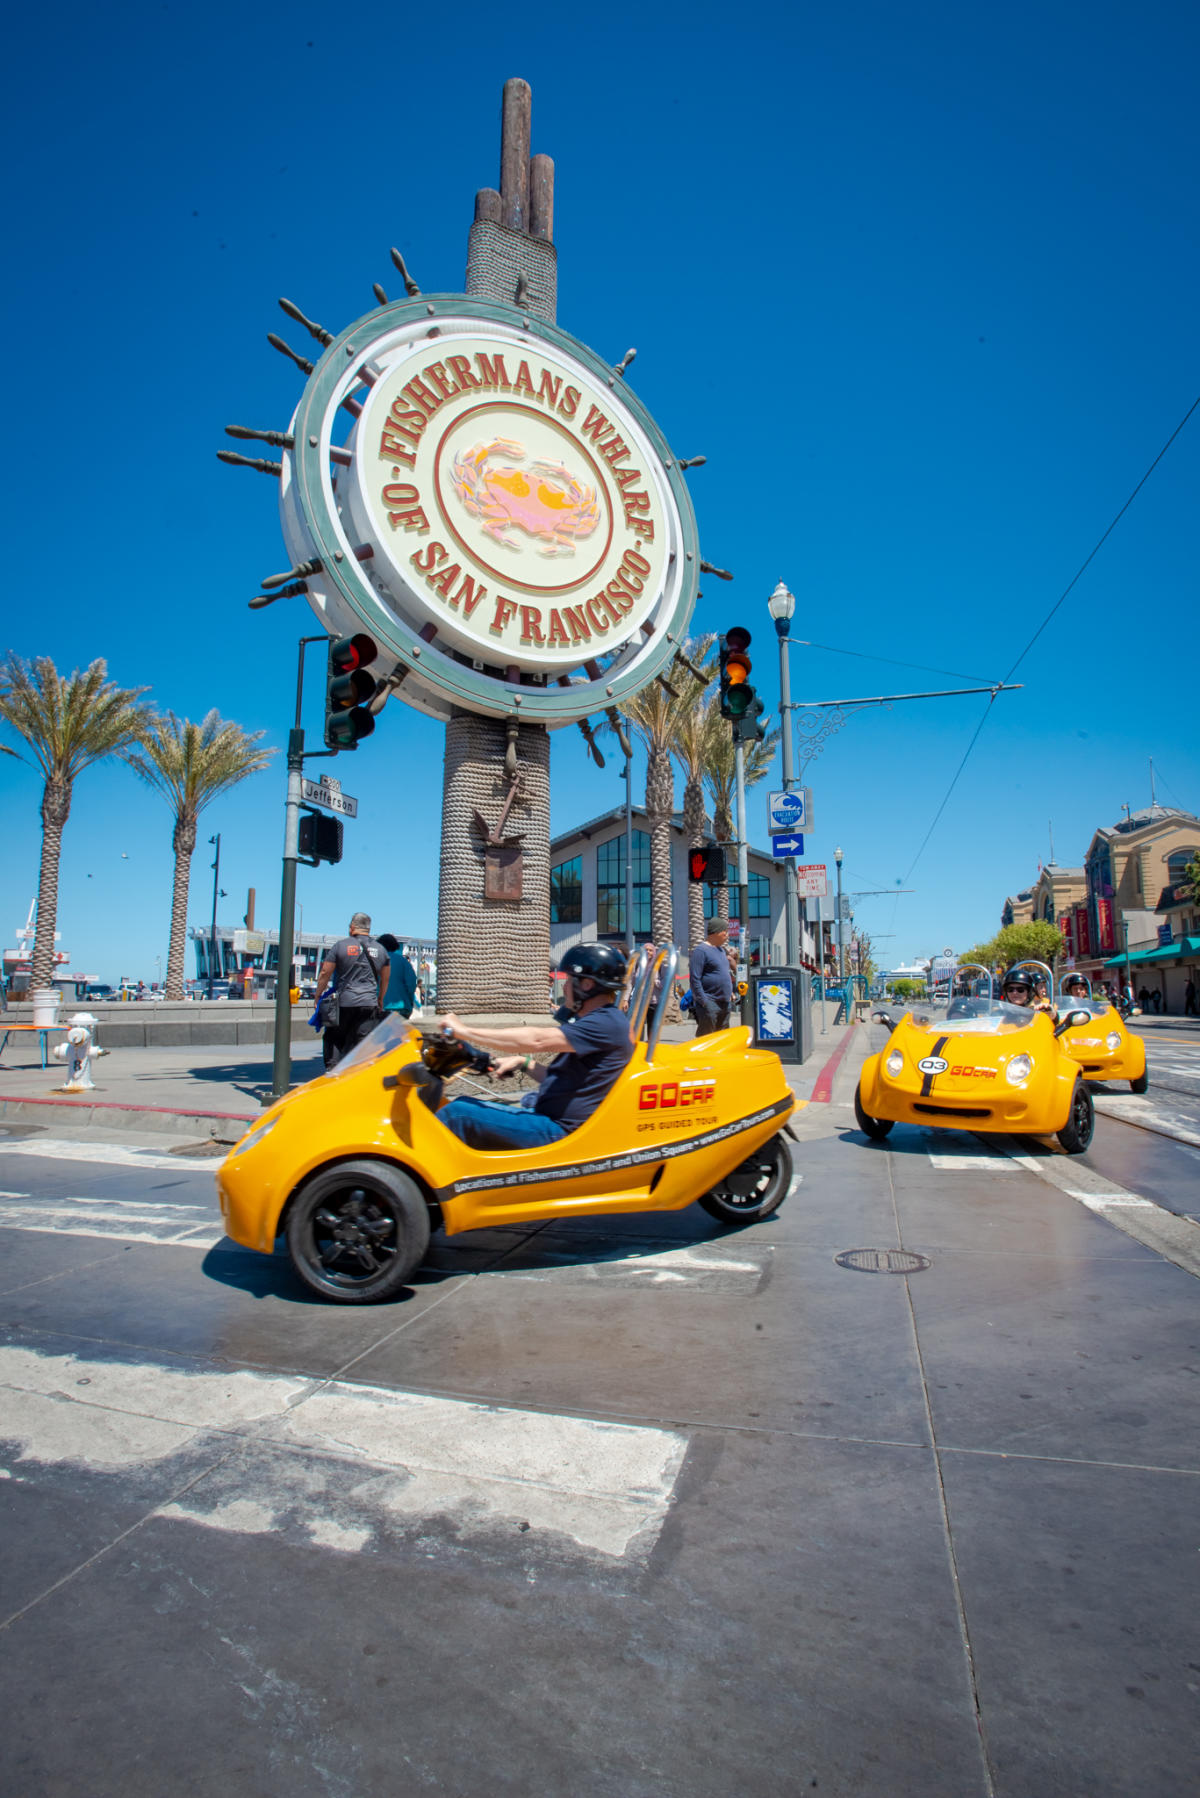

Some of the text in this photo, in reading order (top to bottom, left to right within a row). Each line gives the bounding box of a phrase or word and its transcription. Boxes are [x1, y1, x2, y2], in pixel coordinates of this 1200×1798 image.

[379, 351, 655, 543] FISHERMANS WHARF
[382, 483, 652, 644] OF SAN FRANCISCO
[306, 785, 353, 812] Jefferson
[921, 1061, 946, 1071] 03
[637, 1116, 718, 1132] GPS GUIDED TOUR
[506, 1175, 517, 1184] at
[581, 1160, 611, 1174] Wharf
[612, 1155, 632, 1168] and
[631, 1150, 661, 1163] Union
[661, 1141, 694, 1157] Square
